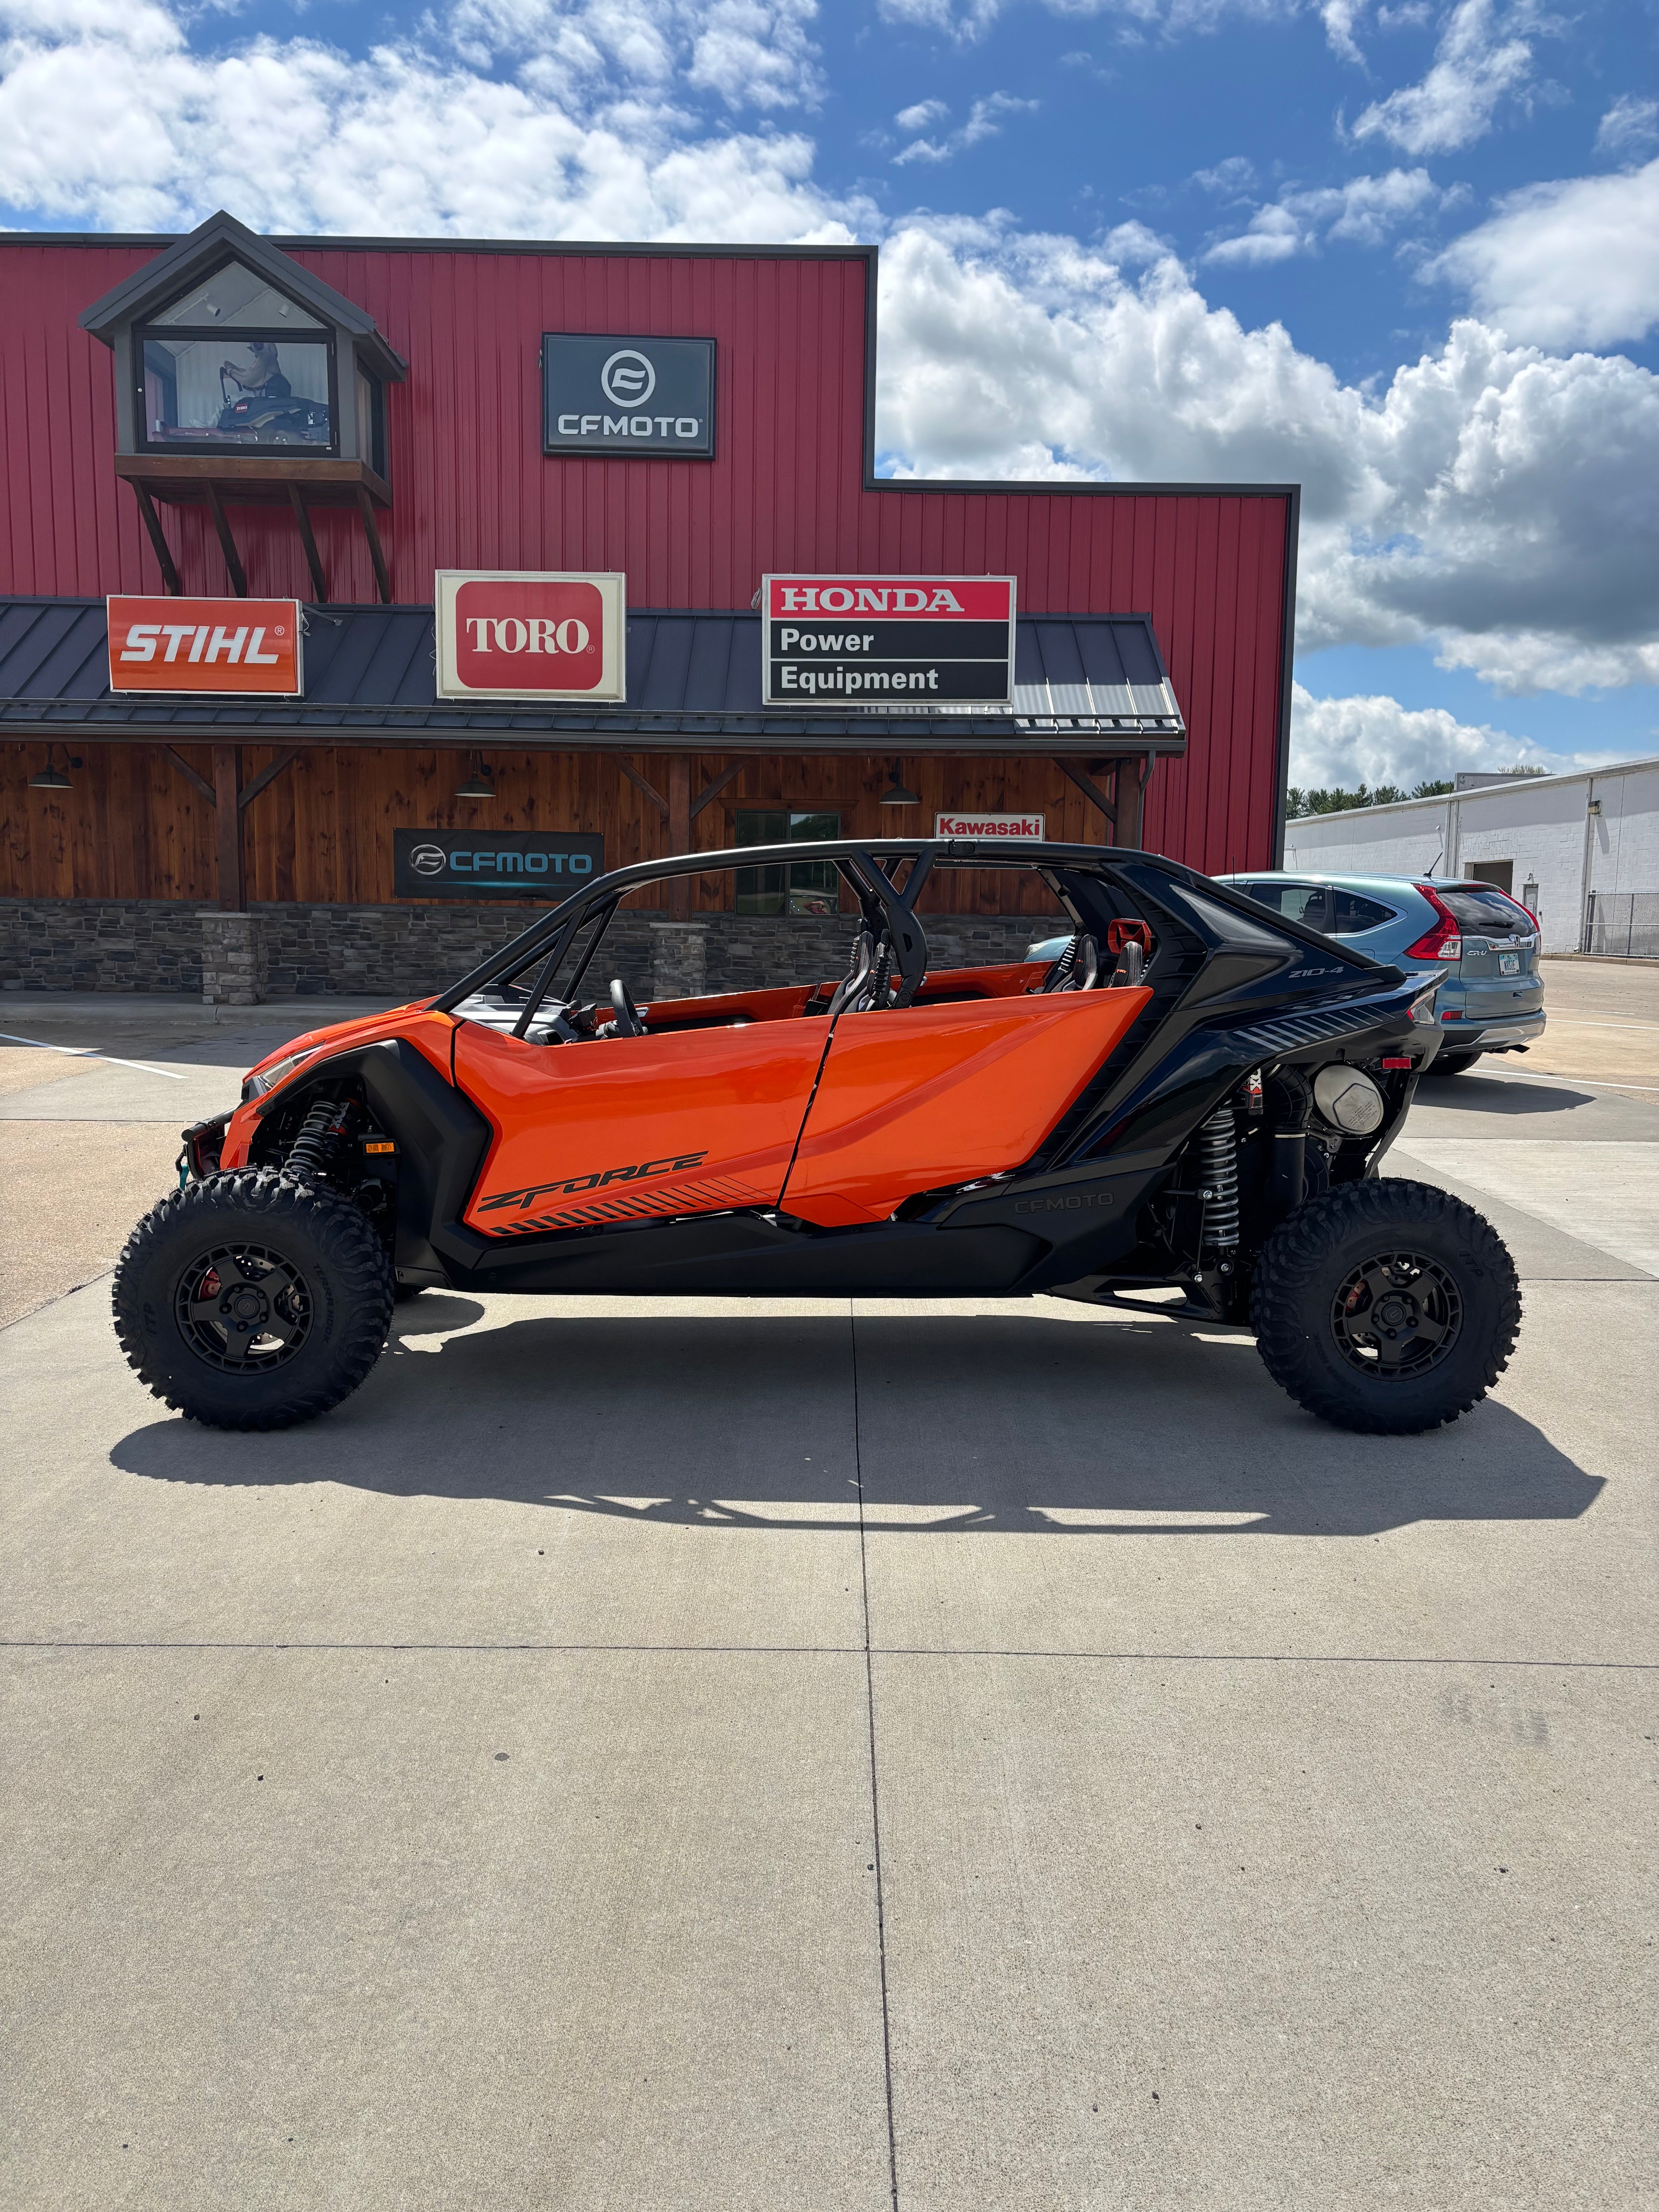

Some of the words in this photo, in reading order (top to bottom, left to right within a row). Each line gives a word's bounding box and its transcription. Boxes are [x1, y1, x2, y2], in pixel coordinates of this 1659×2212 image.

[558, 414, 698, 438] CFMOTO
[781, 587, 965, 612] HONDA
[120, 625, 278, 664] STIHL
[466, 618, 589, 654] TORO
[781, 628, 874, 651] Power
[781, 666, 939, 694] Equipment
[939, 817, 1040, 836] Kawasaki
[450, 851, 592, 874] CFMOTO
[477, 1150, 709, 1213] ZFORCE
[1014, 1192, 1114, 1214] CFMOTO
